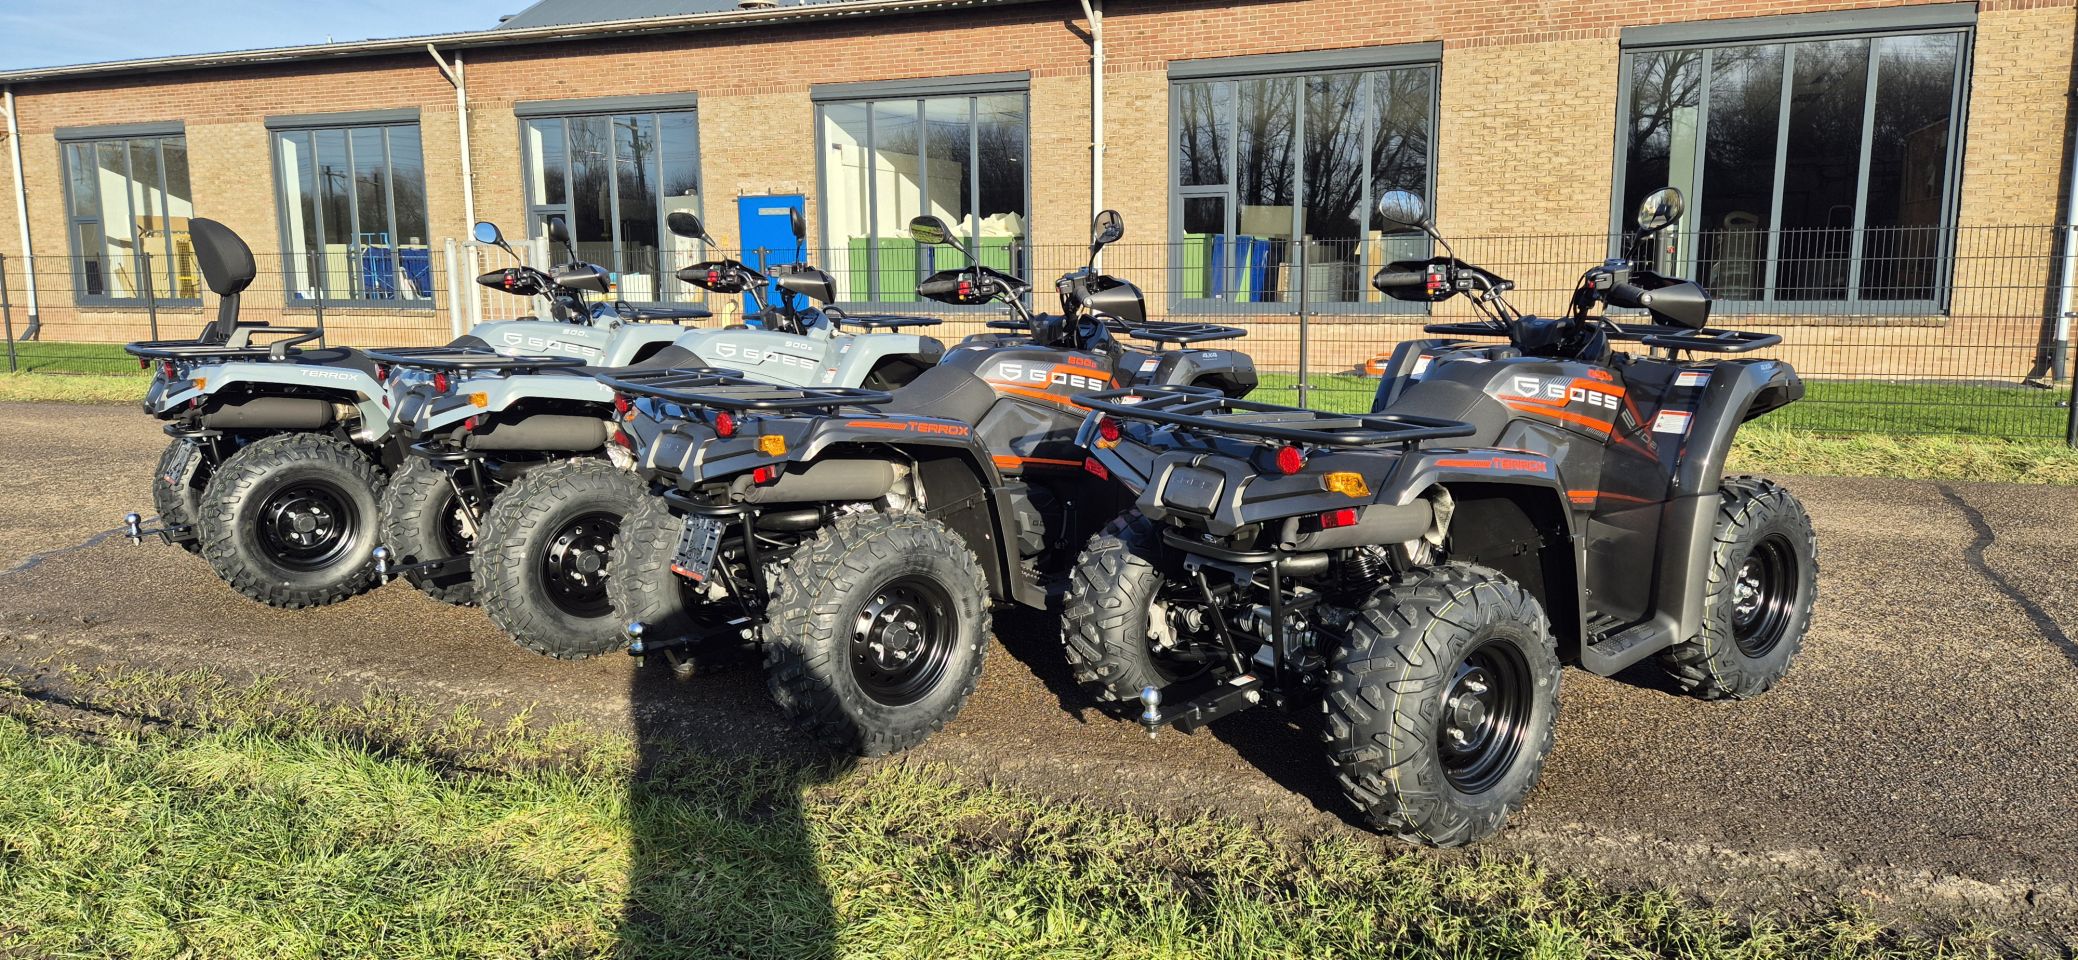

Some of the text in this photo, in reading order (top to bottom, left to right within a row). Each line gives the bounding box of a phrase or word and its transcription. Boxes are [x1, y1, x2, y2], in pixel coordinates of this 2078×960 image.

[528, 337, 595, 357] GOES
[743, 348, 815, 370] GOES
[300, 369, 360, 381] TERROX
[1029, 369, 1103, 392] GOES
[1547, 383, 1618, 410] GOES
[908, 421, 969, 436] TERROX
